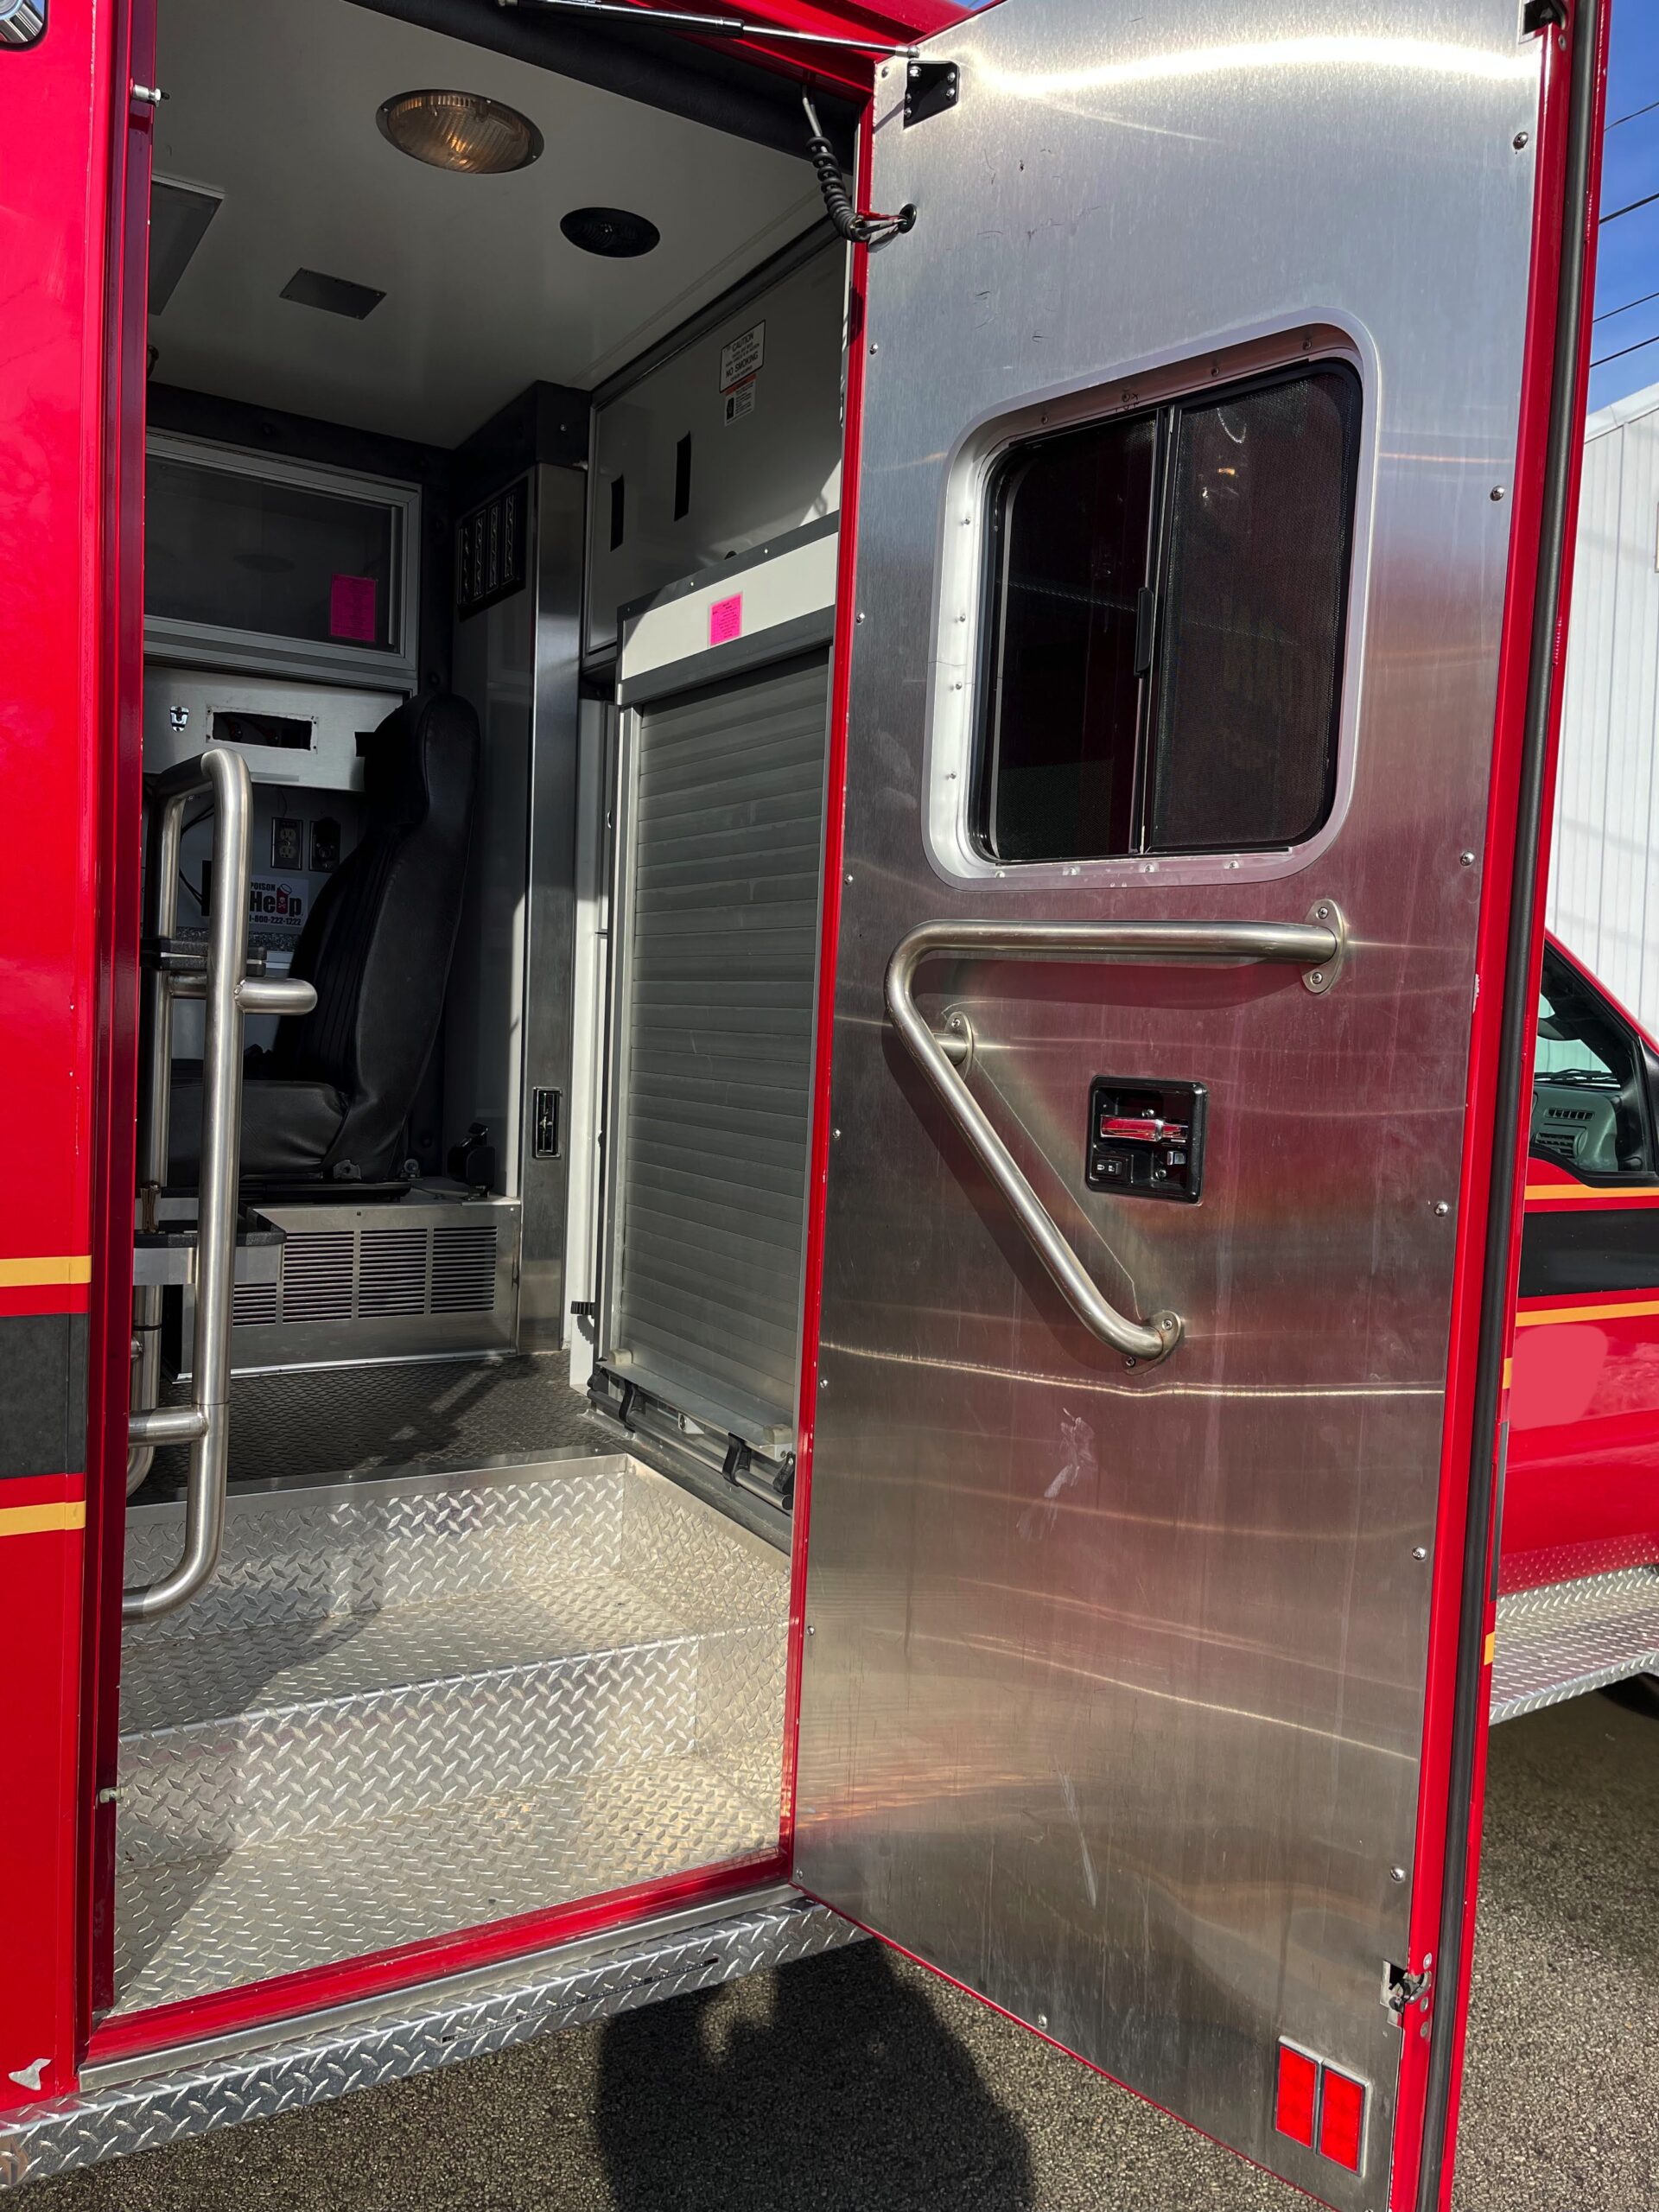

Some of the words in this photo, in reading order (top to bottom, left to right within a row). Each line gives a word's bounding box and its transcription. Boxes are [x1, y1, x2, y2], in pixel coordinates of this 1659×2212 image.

[732, 331, 754, 352] CAUTION
[726, 366, 734, 378] NO
[734, 351, 759, 372] SMOKING
[251, 882, 276, 892] POISON
[249, 888, 302, 917] Help
